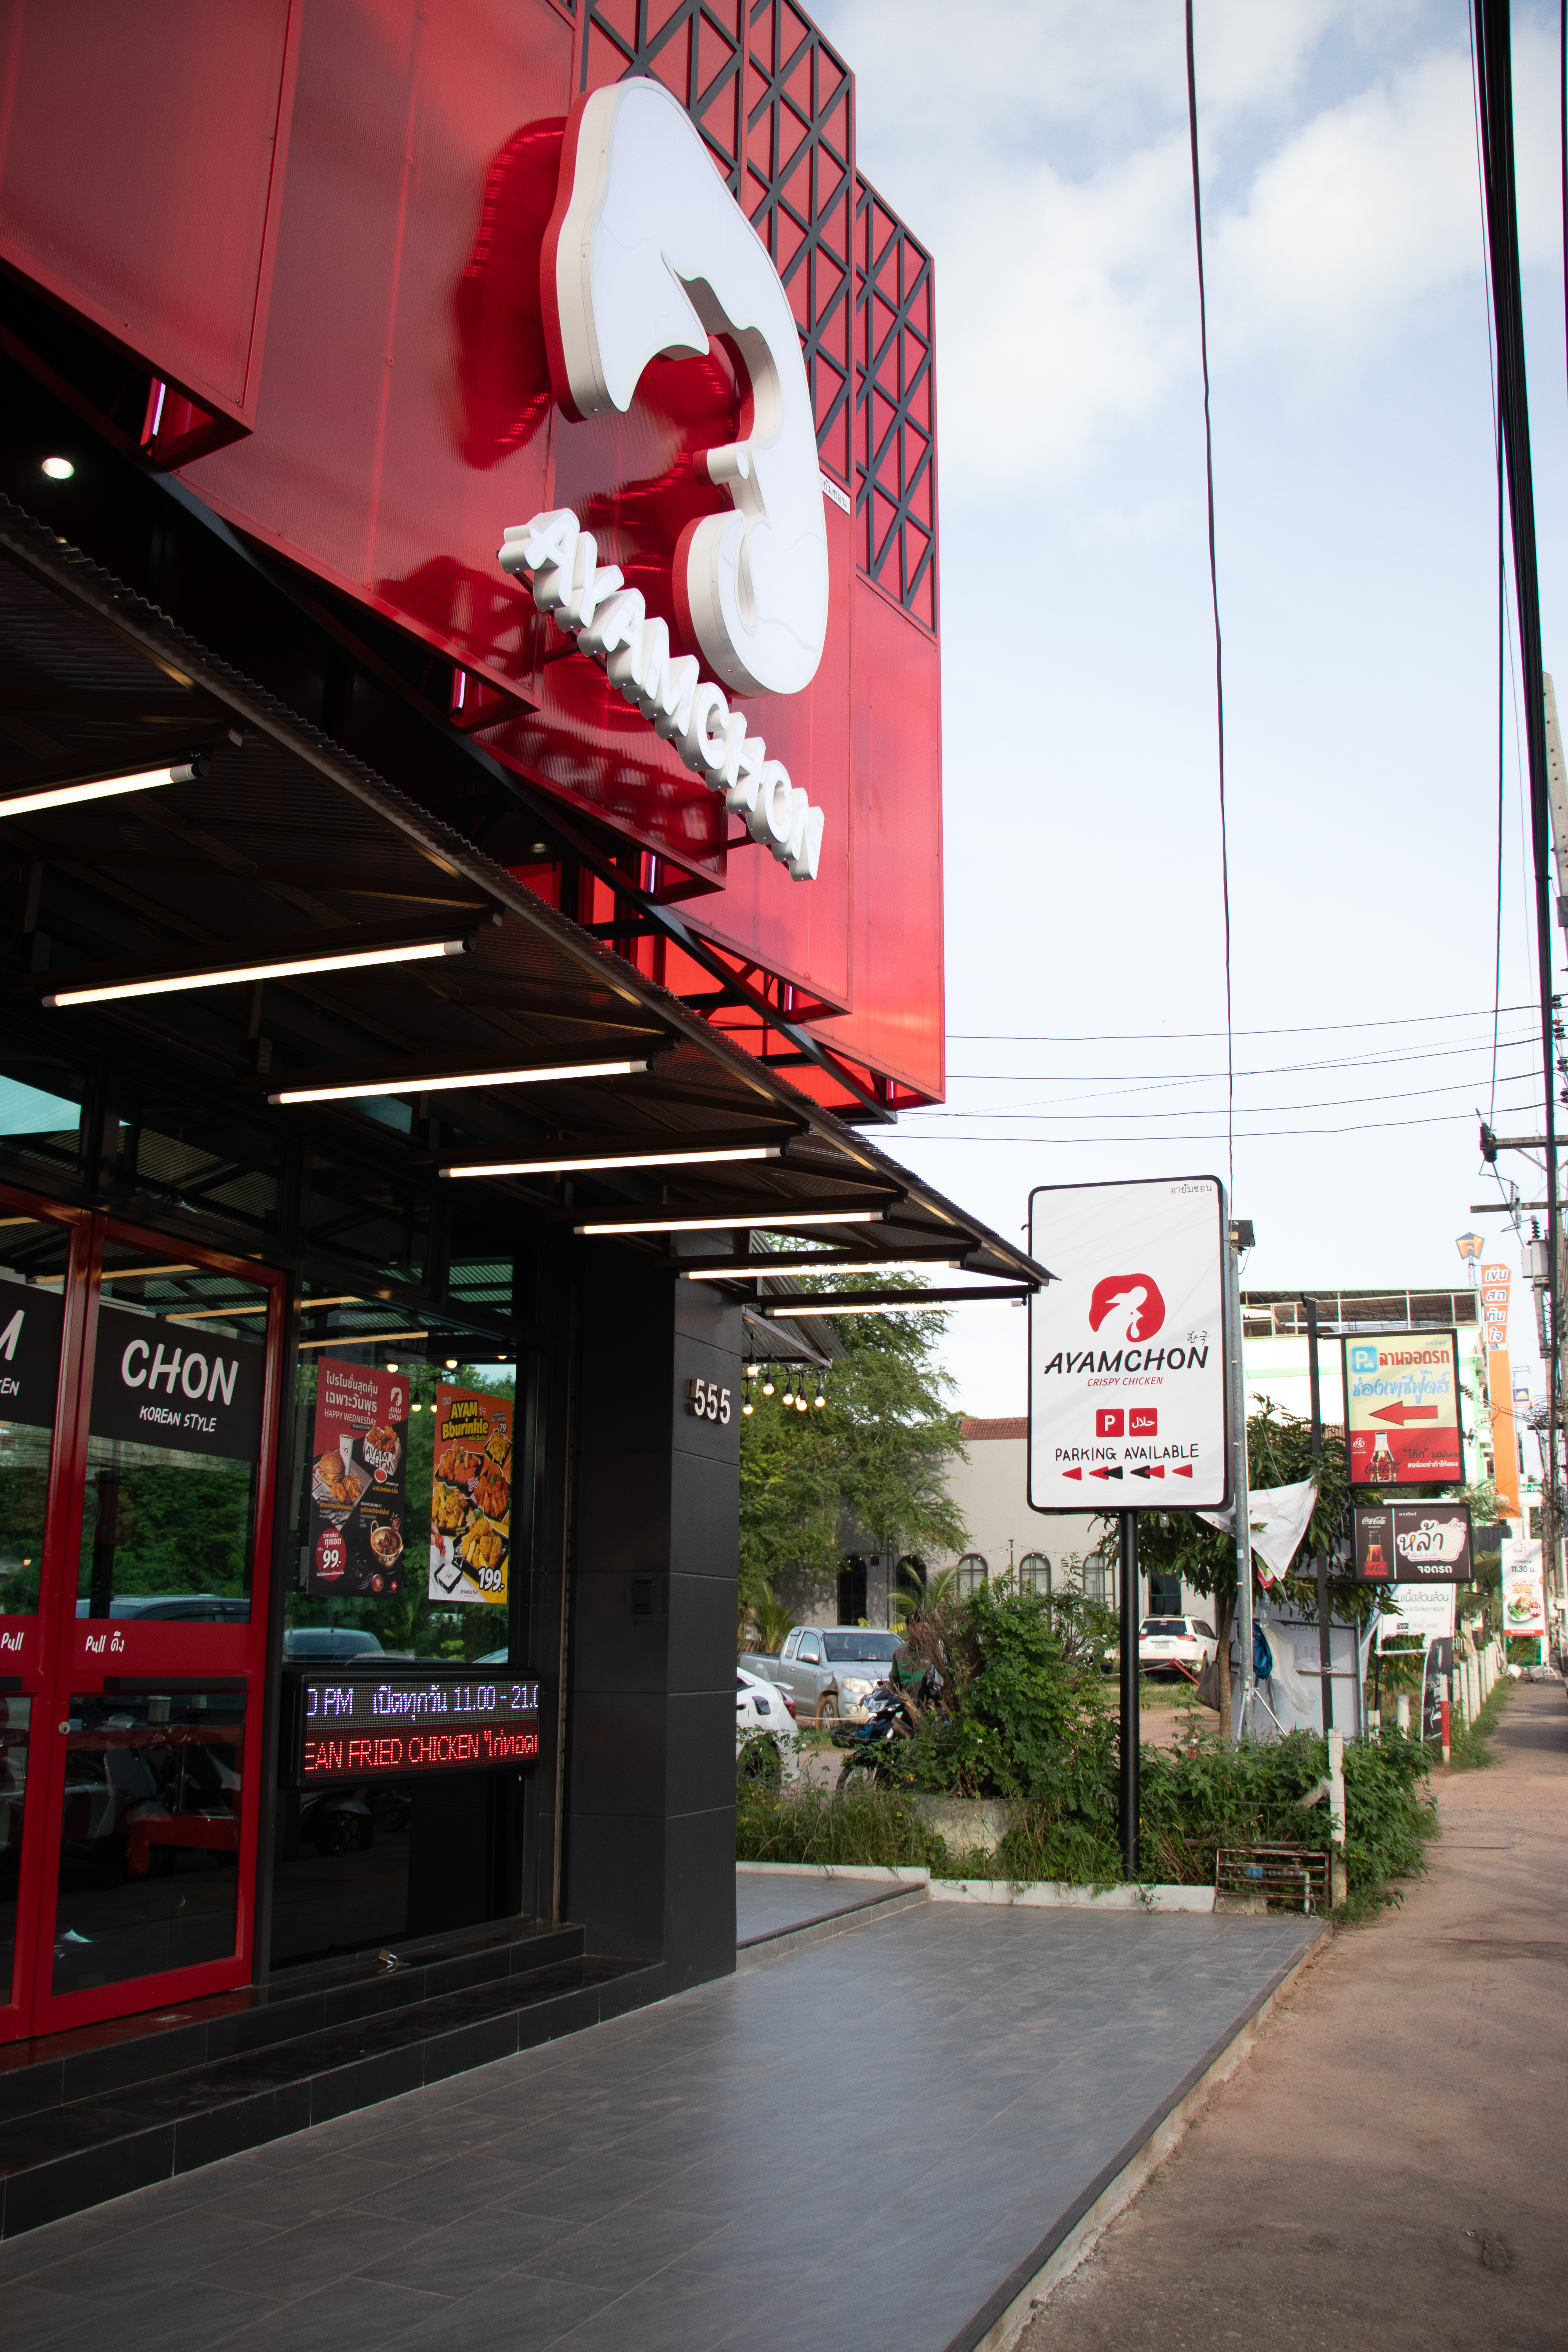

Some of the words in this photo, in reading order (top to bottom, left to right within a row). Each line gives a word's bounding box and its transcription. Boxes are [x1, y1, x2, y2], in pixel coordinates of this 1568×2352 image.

[820, 477, 847, 508] ายัมชอน
[499, 508, 825, 881] AYAMCHON
[1170, 1183, 1212, 1194] อายัมชอน
[1485, 1267, 1508, 1281] เงิน
[1486, 1289, 1506, 1301] สด
[1488, 1307, 1506, 1321] ทัน
[1489, 1327, 1503, 1342] ใจ
[1044, 1346, 1209, 1374] AYAMCHON
[1379, 1350, 1450, 1366] ลานจอดรถ
[122, 1339, 239, 1405] CHON
[0, 1377, 20, 1396] EN
[326, 1370, 378, 1397] โปรโมชั่นสุดคุ้ม
[1087, 1378, 1120, 1387] CRISPY
[1122, 1376, 1163, 1386] CHICKEN
[326, 1391, 377, 1416] เฉพาะวันพุธ
[389, 1406, 402, 1414] AYAM
[451, 1401, 478, 1419] AYAM
[690, 1378, 731, 1424] 555
[140, 1405, 181, 1426] KOREAN
[183, 1413, 217, 1432] STYLE
[325, 1408, 343, 1419] HAPPY
[344, 1412, 377, 1425] WEDNESDAY
[388, 1413, 402, 1421] CHON
[1104, 1415, 1115, 1431] P
[1132, 1416, 1155, 1428] حلال
[442, 1417, 489, 1439] Bburinkle
[366, 1445, 389, 1461] AYAM
[1055, 1447, 1117, 1461] PARKING
[1124, 1443, 1199, 1459] AVAILABLE
[1399, 1522, 1444, 1552] หล้า
[1510, 1578, 1536, 1587] SPECIAL
[1, 1632, 24, 1651] Pull
[85, 1635, 107, 1653] Pull
[111, 1631, 125, 1652] ดึง
[454, 1686, 495, 1711] 11.00
[348, 1739, 402, 1767] FRIED
[408, 1734, 478, 1762] CHICKEN
